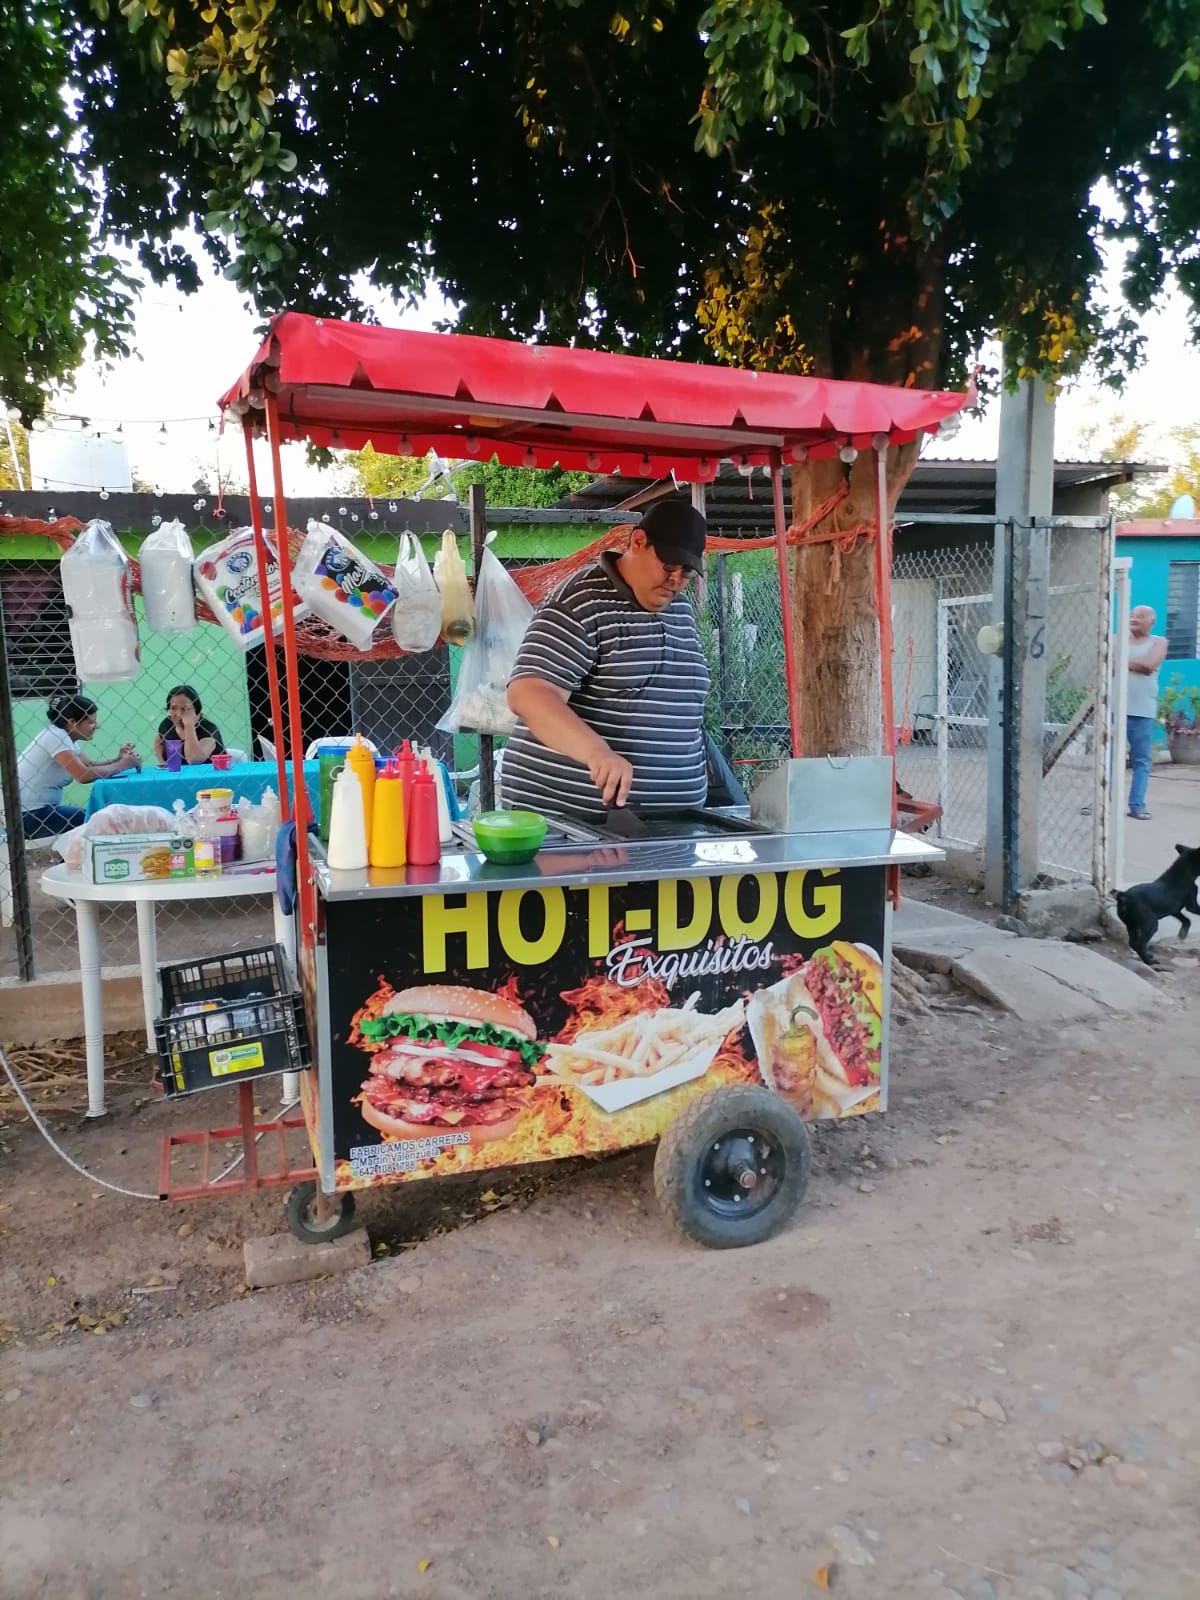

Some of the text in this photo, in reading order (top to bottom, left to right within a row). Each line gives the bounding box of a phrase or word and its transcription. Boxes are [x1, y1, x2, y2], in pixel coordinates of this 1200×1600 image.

[105, 862, 128, 871] FOOD
[422, 868, 842, 975] HOT-DOG
[606, 932, 774, 991] Exquisitos
[351, 1132, 470, 1159] FABRICAMOS CARRETAS
[390, 1148, 440, 1163] Valenzuela
[359, 1167, 375, 1177] 642
[377, 1163, 393, 1174] 108
